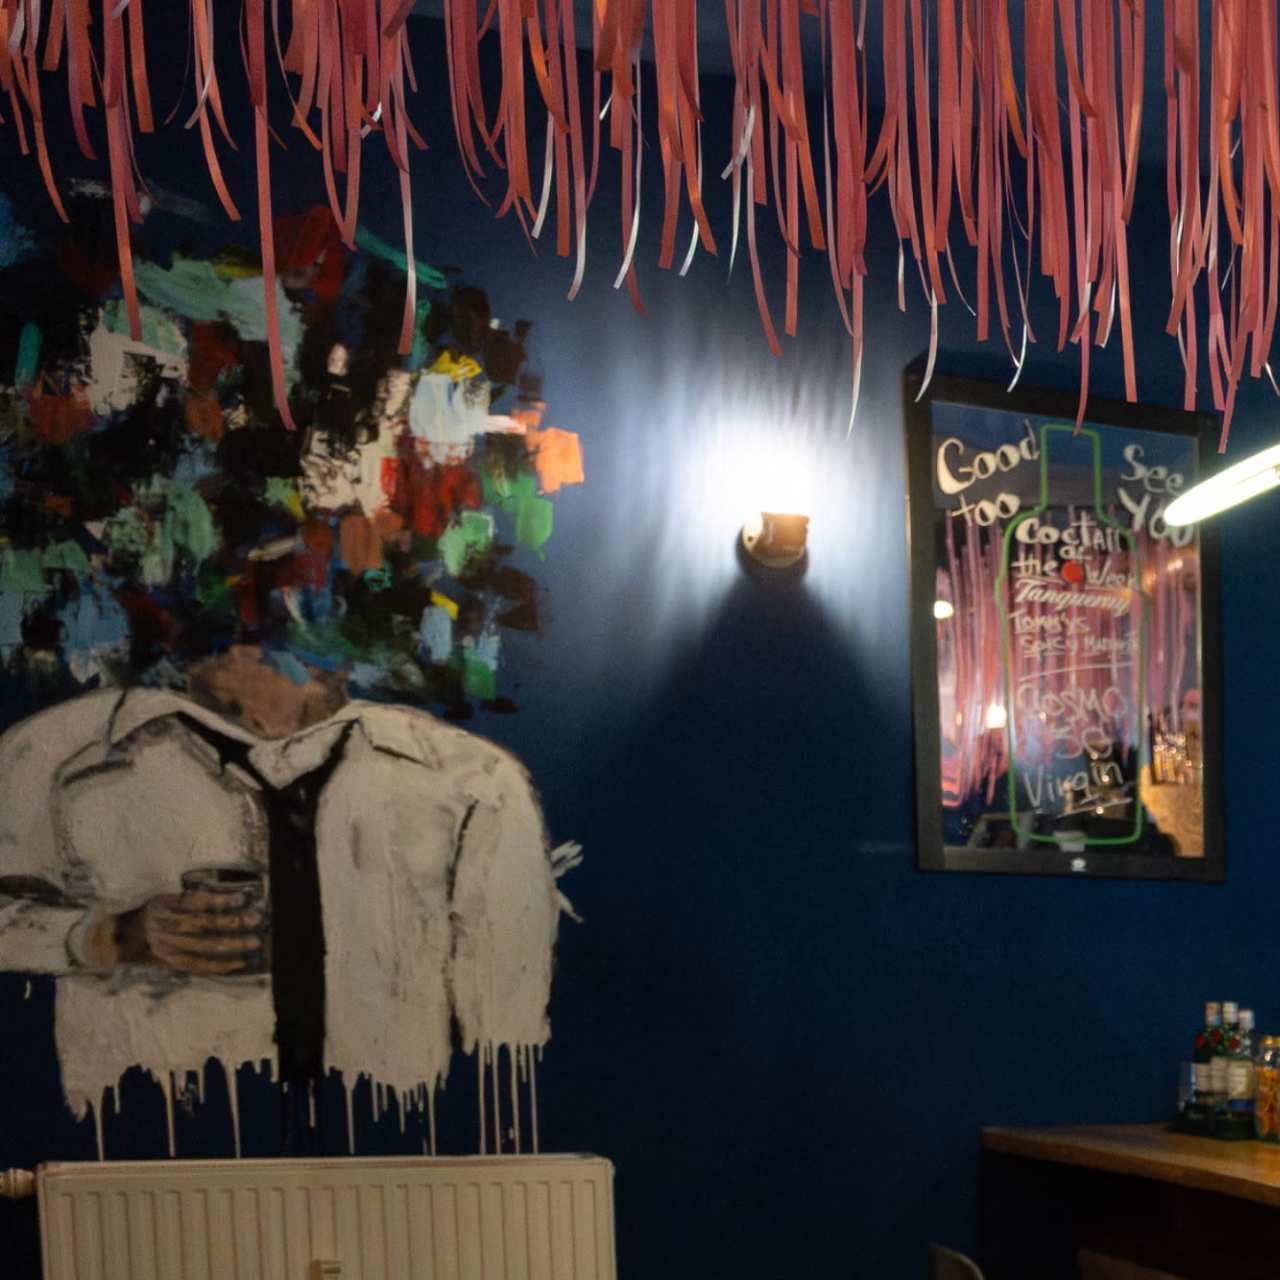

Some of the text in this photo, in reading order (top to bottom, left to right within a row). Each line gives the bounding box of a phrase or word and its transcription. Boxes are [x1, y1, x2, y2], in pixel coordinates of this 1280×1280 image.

[937, 418, 1040, 495] Good
[1120, 444, 1185, 496] See
[952, 492, 1021, 528] too
